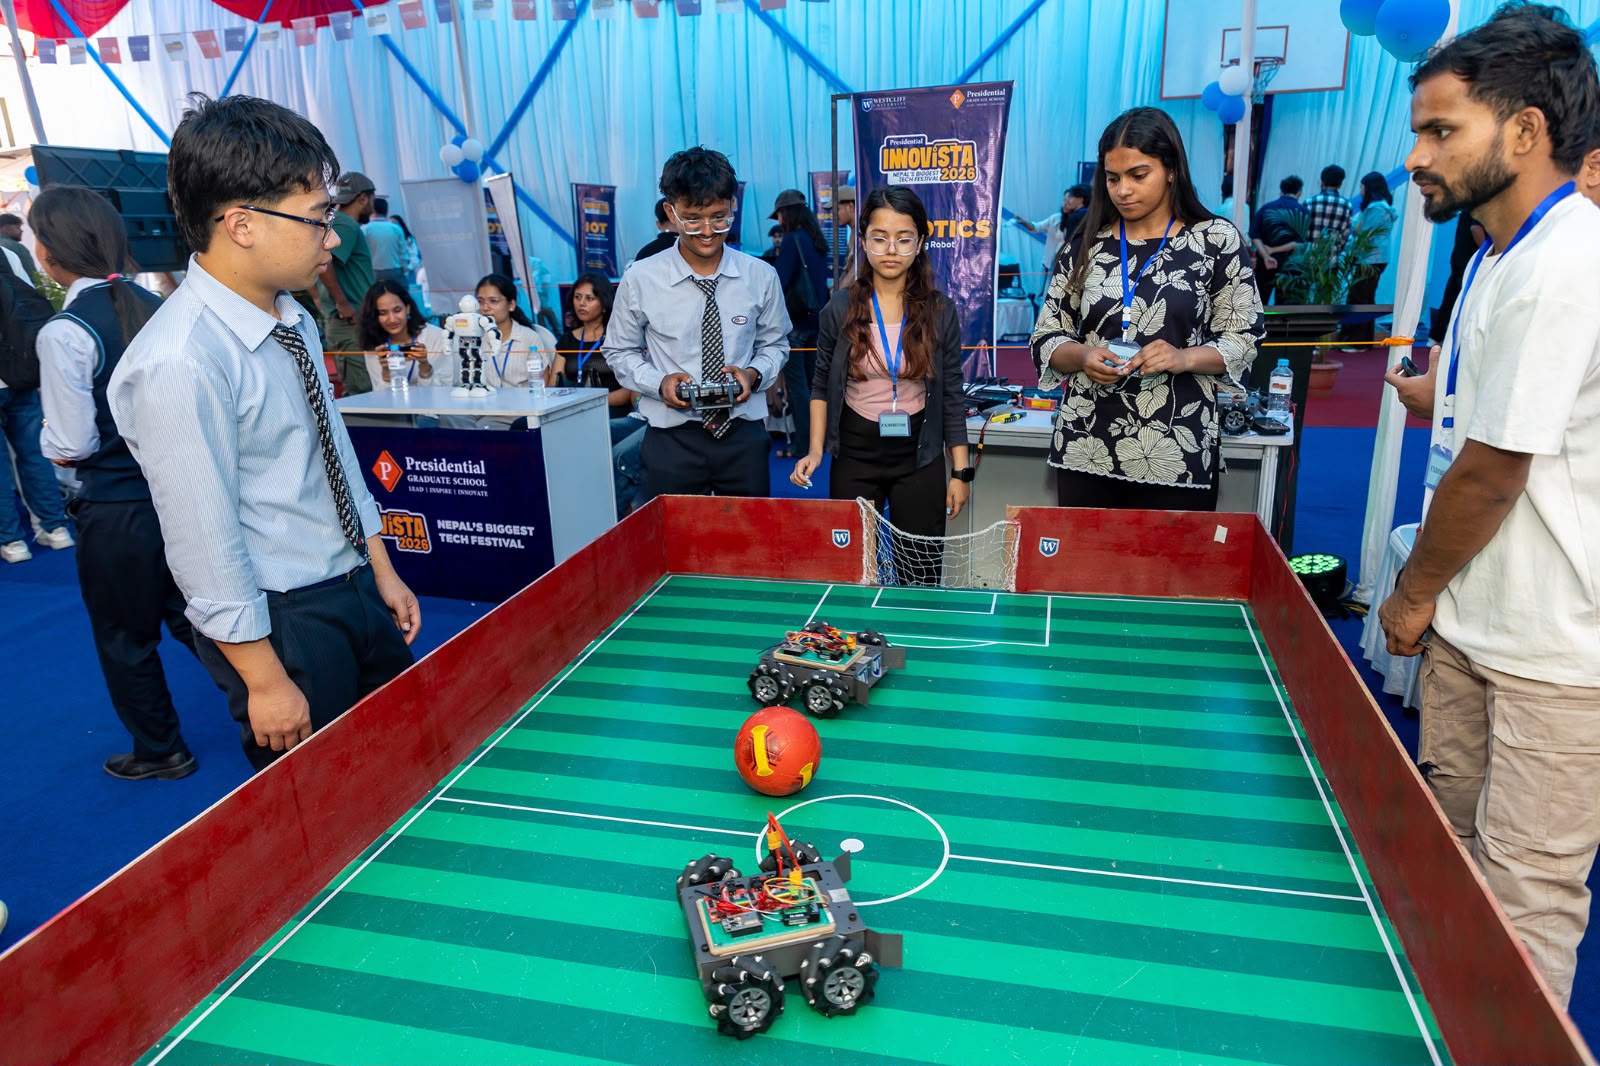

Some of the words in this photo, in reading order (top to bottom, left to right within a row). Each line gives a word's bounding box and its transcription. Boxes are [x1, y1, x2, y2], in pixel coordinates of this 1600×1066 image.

[966, 88, 1006, 98] Presidential
[889, 137, 924, 146] Presidential
[941, 167, 976, 181] 2026
[585, 221, 608, 234] IOT
[930, 240, 956, 248] Robot
[379, 461, 392, 480] P
[405, 456, 486, 475] Presidential
[407, 474, 451, 485] GRADUATE
[452, 478, 487, 487] SCHOOL
[429, 487, 452, 495] INSPIRE
[457, 489, 489, 497] INNOVATE
[437, 519, 484, 532] NEPAL'S
[485, 524, 535, 536] BIGGEST
[398, 537, 429, 551] 2026
[439, 533, 469, 545] TECH
[470, 536, 525, 549] FESTIVAL
[834, 533, 848, 544] W
[1042, 541, 1057, 552] W
